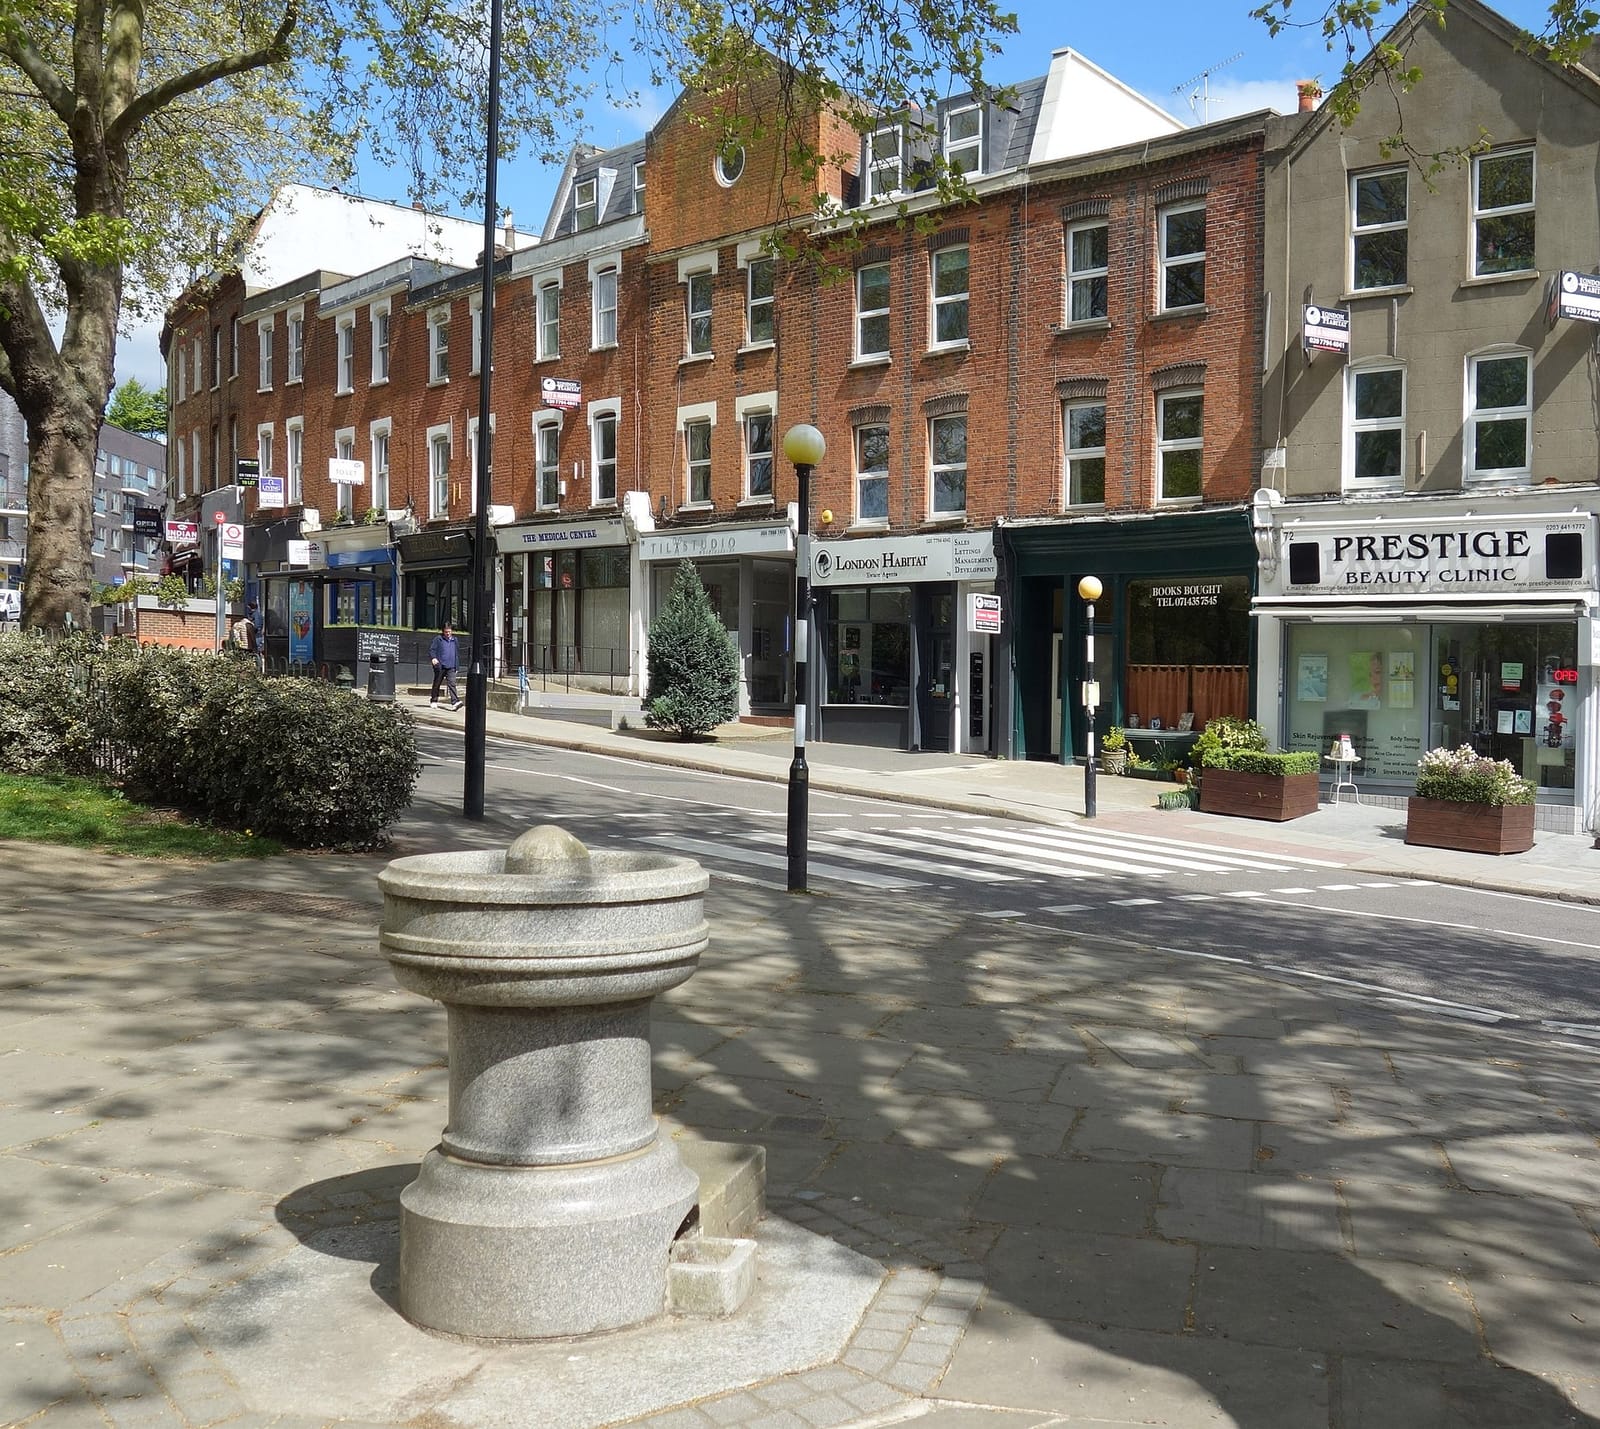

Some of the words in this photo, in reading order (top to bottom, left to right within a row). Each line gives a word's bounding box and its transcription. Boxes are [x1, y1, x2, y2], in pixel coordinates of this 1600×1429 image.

[167, 530, 197, 539] INDIAN
[523, 534, 536, 542] THE
[539, 531, 568, 542] MEDICAL
[570, 529, 597, 539] CENTRE
[1283, 532, 1294, 540] 72
[1333, 530, 1531, 561] PRESTIGE
[835, 556, 879, 570] LONDON
[882, 552, 928, 568] HABITAT
[1346, 570, 1430, 584] BEAUTY
[1438, 568, 1516, 582] CLINIC
[1152, 586, 1181, 596] BOOKS
[1184, 584, 1222, 595] BOUGHT
